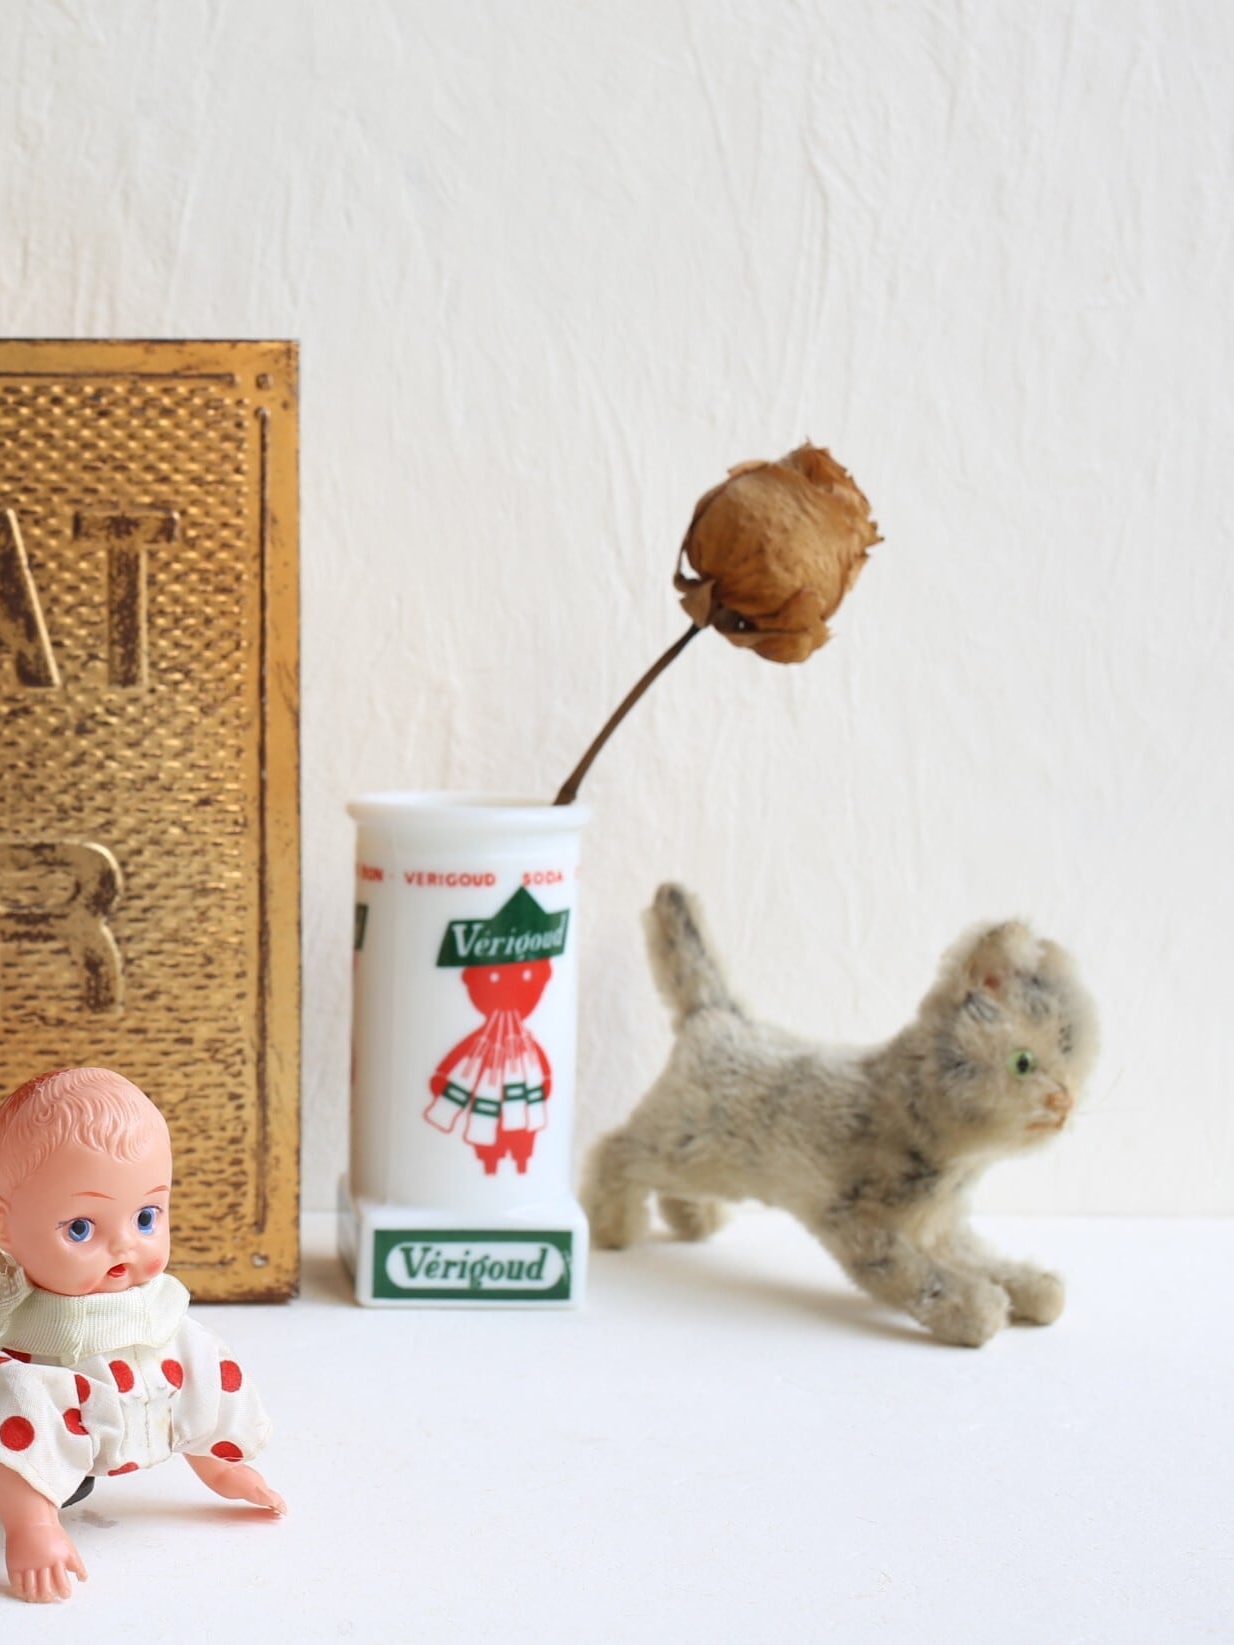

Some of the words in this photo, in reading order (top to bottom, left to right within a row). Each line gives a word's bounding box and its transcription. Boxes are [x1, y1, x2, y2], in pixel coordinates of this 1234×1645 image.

[404, 871, 497, 888] VERIGOUD
[521, 870, 564, 887] SODA
[451, 914, 566, 962] Vérigoud
[399, 1245, 549, 1289] Vérigoud
